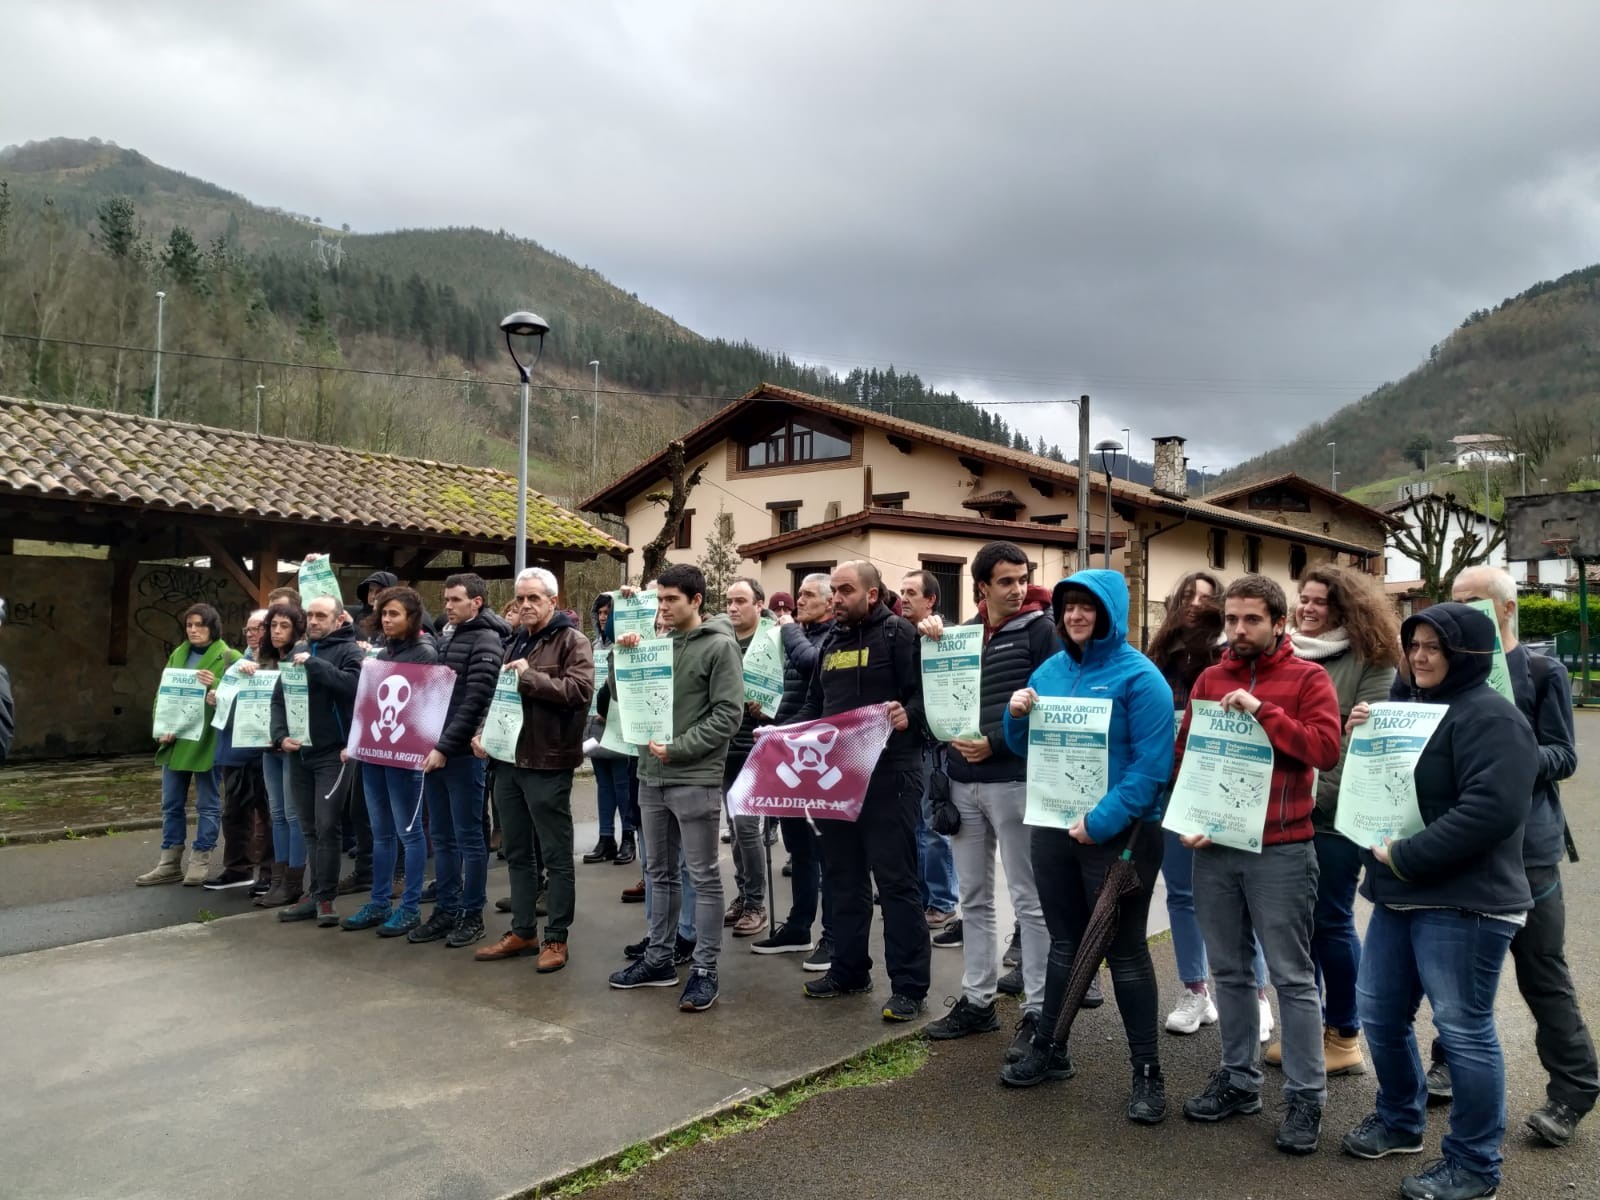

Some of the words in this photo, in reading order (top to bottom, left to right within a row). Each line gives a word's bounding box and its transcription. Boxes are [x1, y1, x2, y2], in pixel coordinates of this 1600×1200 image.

[937, 639, 967, 653] PARO!
[630, 652, 658, 664] PARO!
[1073, 705, 1108, 714] ARGITU
[1044, 712, 1089, 725] PARO!
[1373, 717, 1416, 730] PARO!
[1209, 718, 1255, 736] PARO!
[394, 751, 425, 763] ARGITU
[748, 796, 827, 810] #ZALDIBAR
